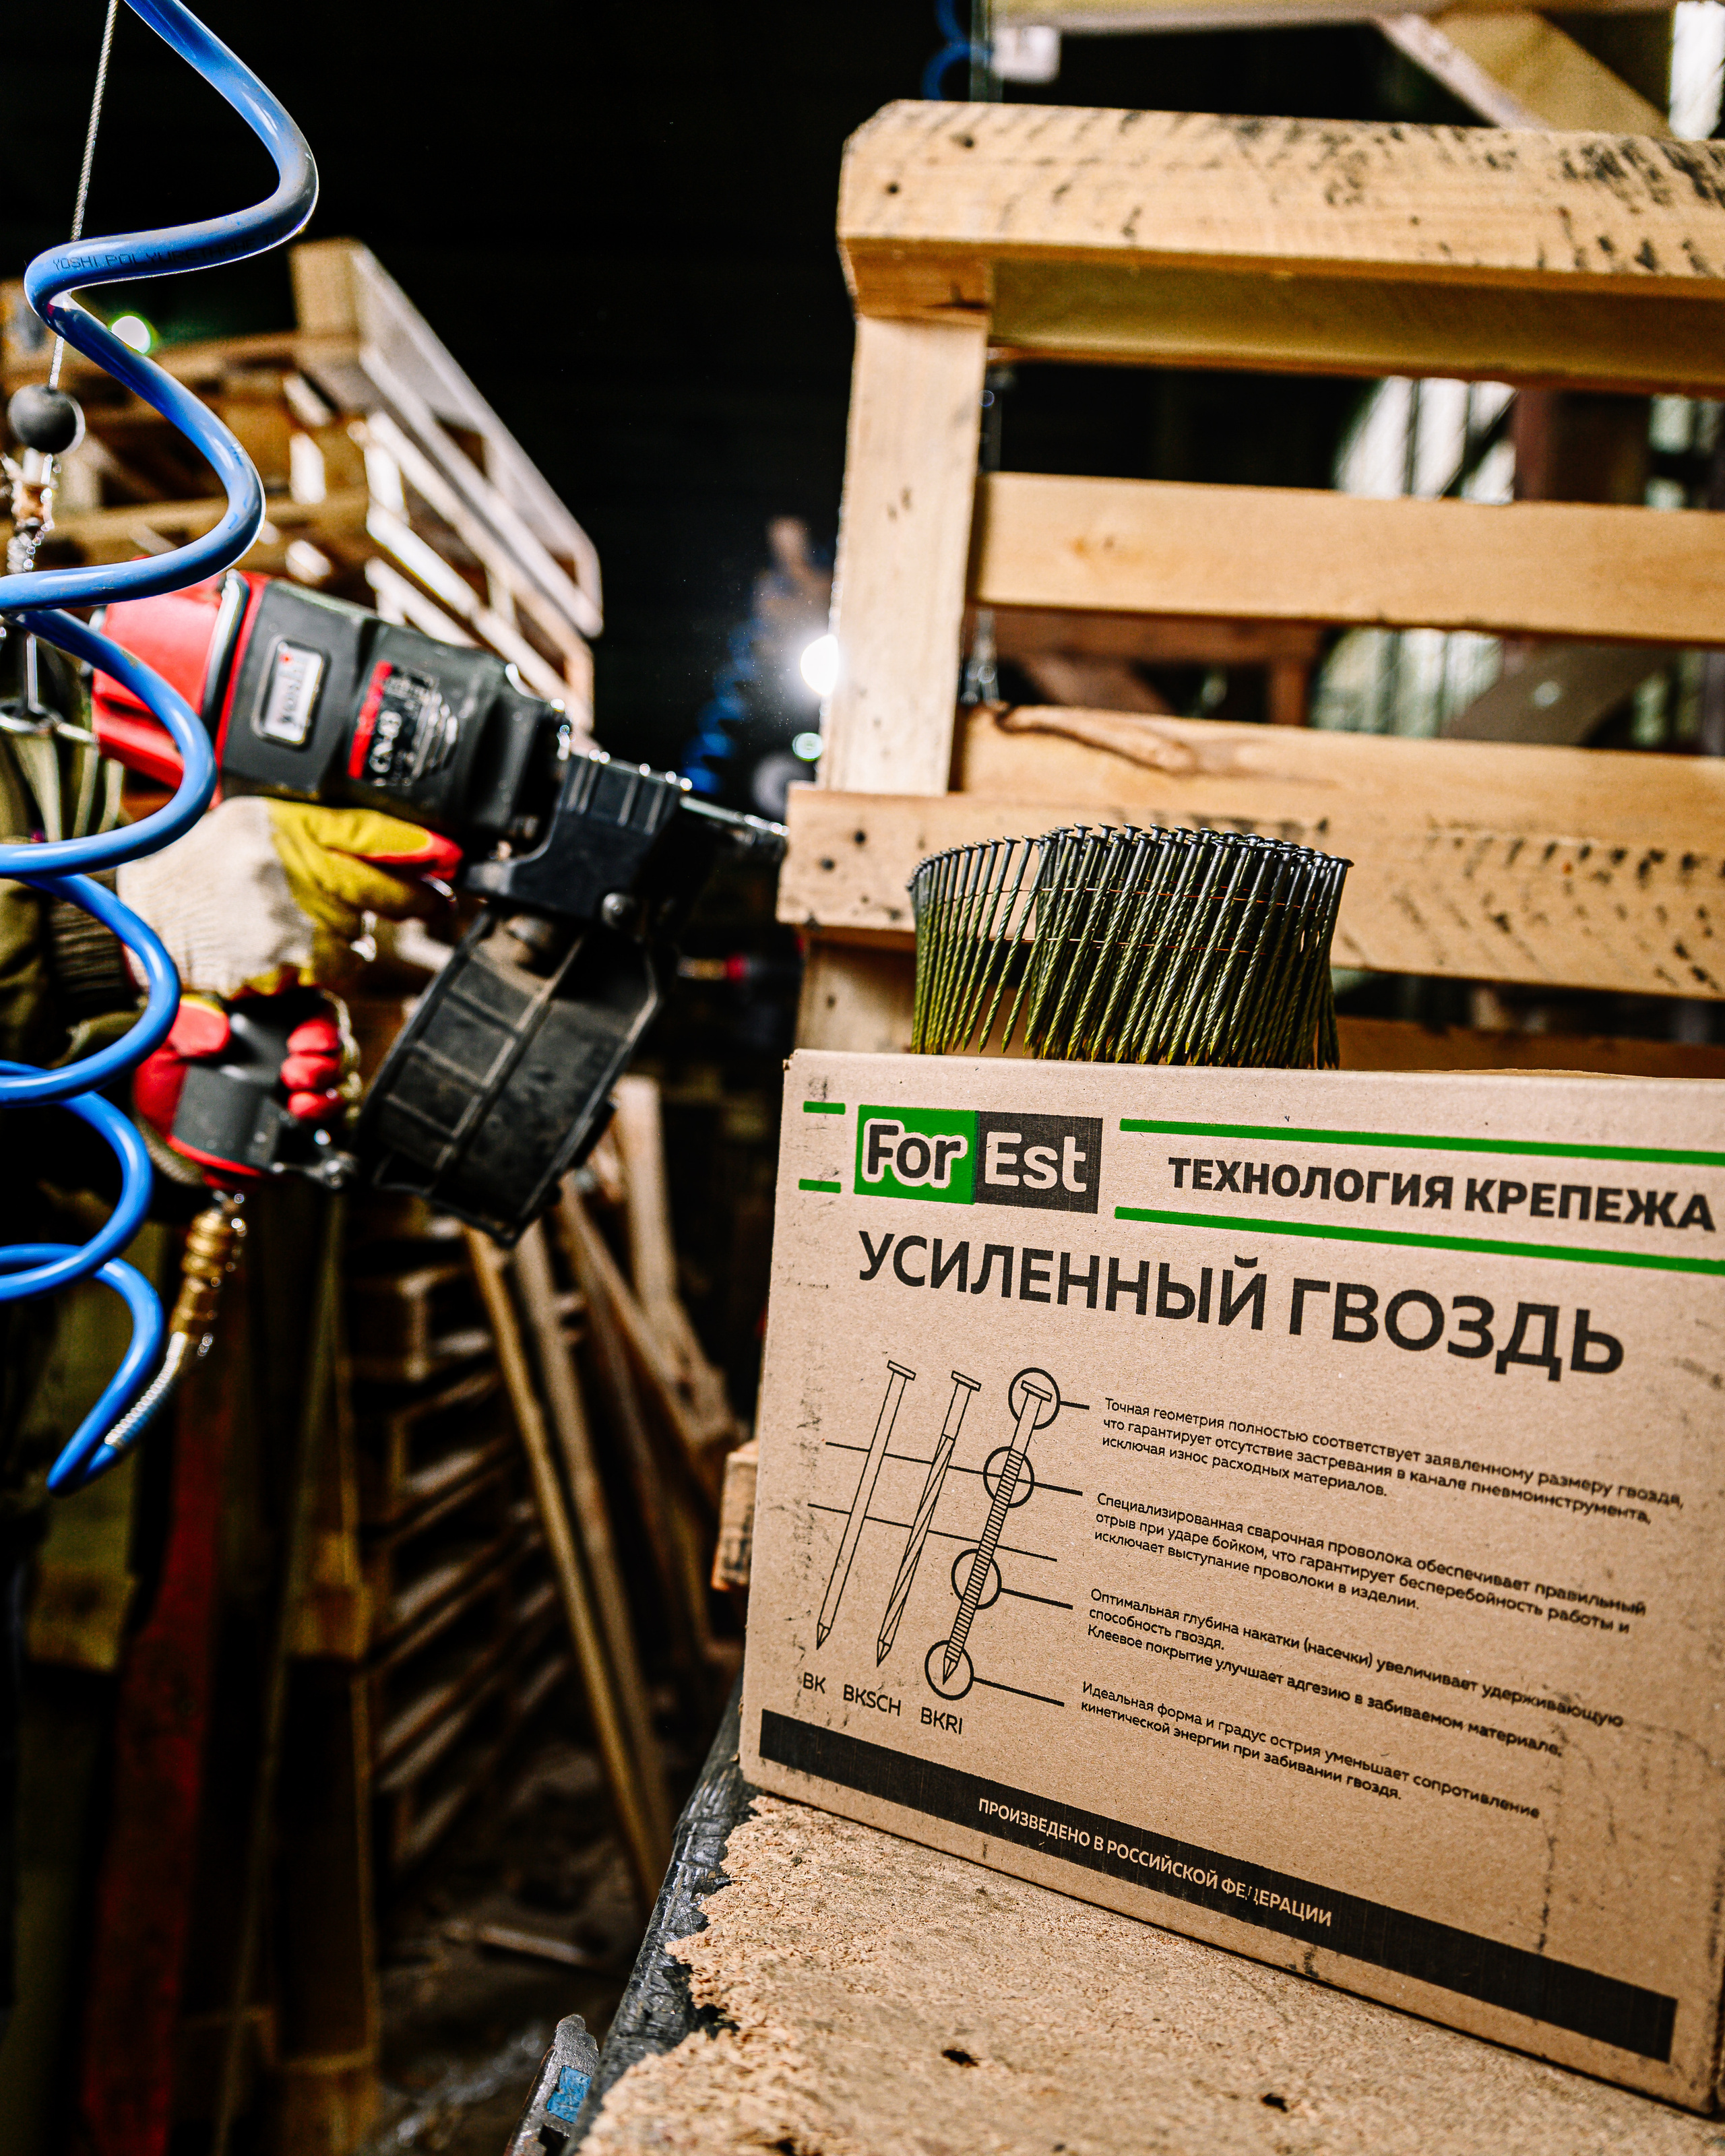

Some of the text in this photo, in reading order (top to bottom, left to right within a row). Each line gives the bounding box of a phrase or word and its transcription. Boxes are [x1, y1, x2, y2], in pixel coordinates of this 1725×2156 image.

[53, 254, 98, 271] YOSHI
[1168, 1156, 1716, 1233] ТЕХНОЛОГИЯ КРЕПЕЖА
[858, 1230, 1625, 1382] УСИЛЕННЫЙ ГВОЗДЬ
[1101, 1436, 1387, 1497] исключая износ расходных материалов.
[1102, 1418, 1652, 1525] что гарантирует отсутствие застревания в канале пневмоинструмента,
[1104, 1395, 1684, 1511] Точная геометрия полностью соответствует заявленному размеру гвоздя,
[1094, 1531, 1420, 1610] исключает выступание проволоки в изделии.
[1095, 1513, 1630, 1635] отрыв при ударе бойком, что гарантирует бесперебойность работы и
[1096, 1491, 1647, 1616] Специализированная сварочная проволока обеспечивает правильный
[1086, 1622, 1143, 1649] Клеевое
[1145, 1641, 1214, 1667] покрытие
[1214, 1657, 1285, 1684] улучшает
[1286, 1676, 1351, 1702] адгезию
[1353, 1692, 1363, 1705] в
[1366, 1696, 1464, 1731] забиваемом
[1088, 1608, 1225, 1651] способность гвоздя.
[1090, 1587, 1627, 1728] Оптимальная глубина накатки (насечки) увеличивает удерживающую
[803, 1671, 827, 1694] BK
[842, 1683, 901, 1717] BKSCH
[918, 1706, 963, 1735] BKRI
[1080, 1701, 1402, 1800] кинетической энергии при забивании гвоздя.
[1081, 1680, 1540, 1820] Идеальная форма и градус острия уменьшает сопротивление
[978, 1798, 1332, 1927] ПРОИЗВЕДЕНО В РОССИЙСКОЙ ФЕДЕРАЦИИ
